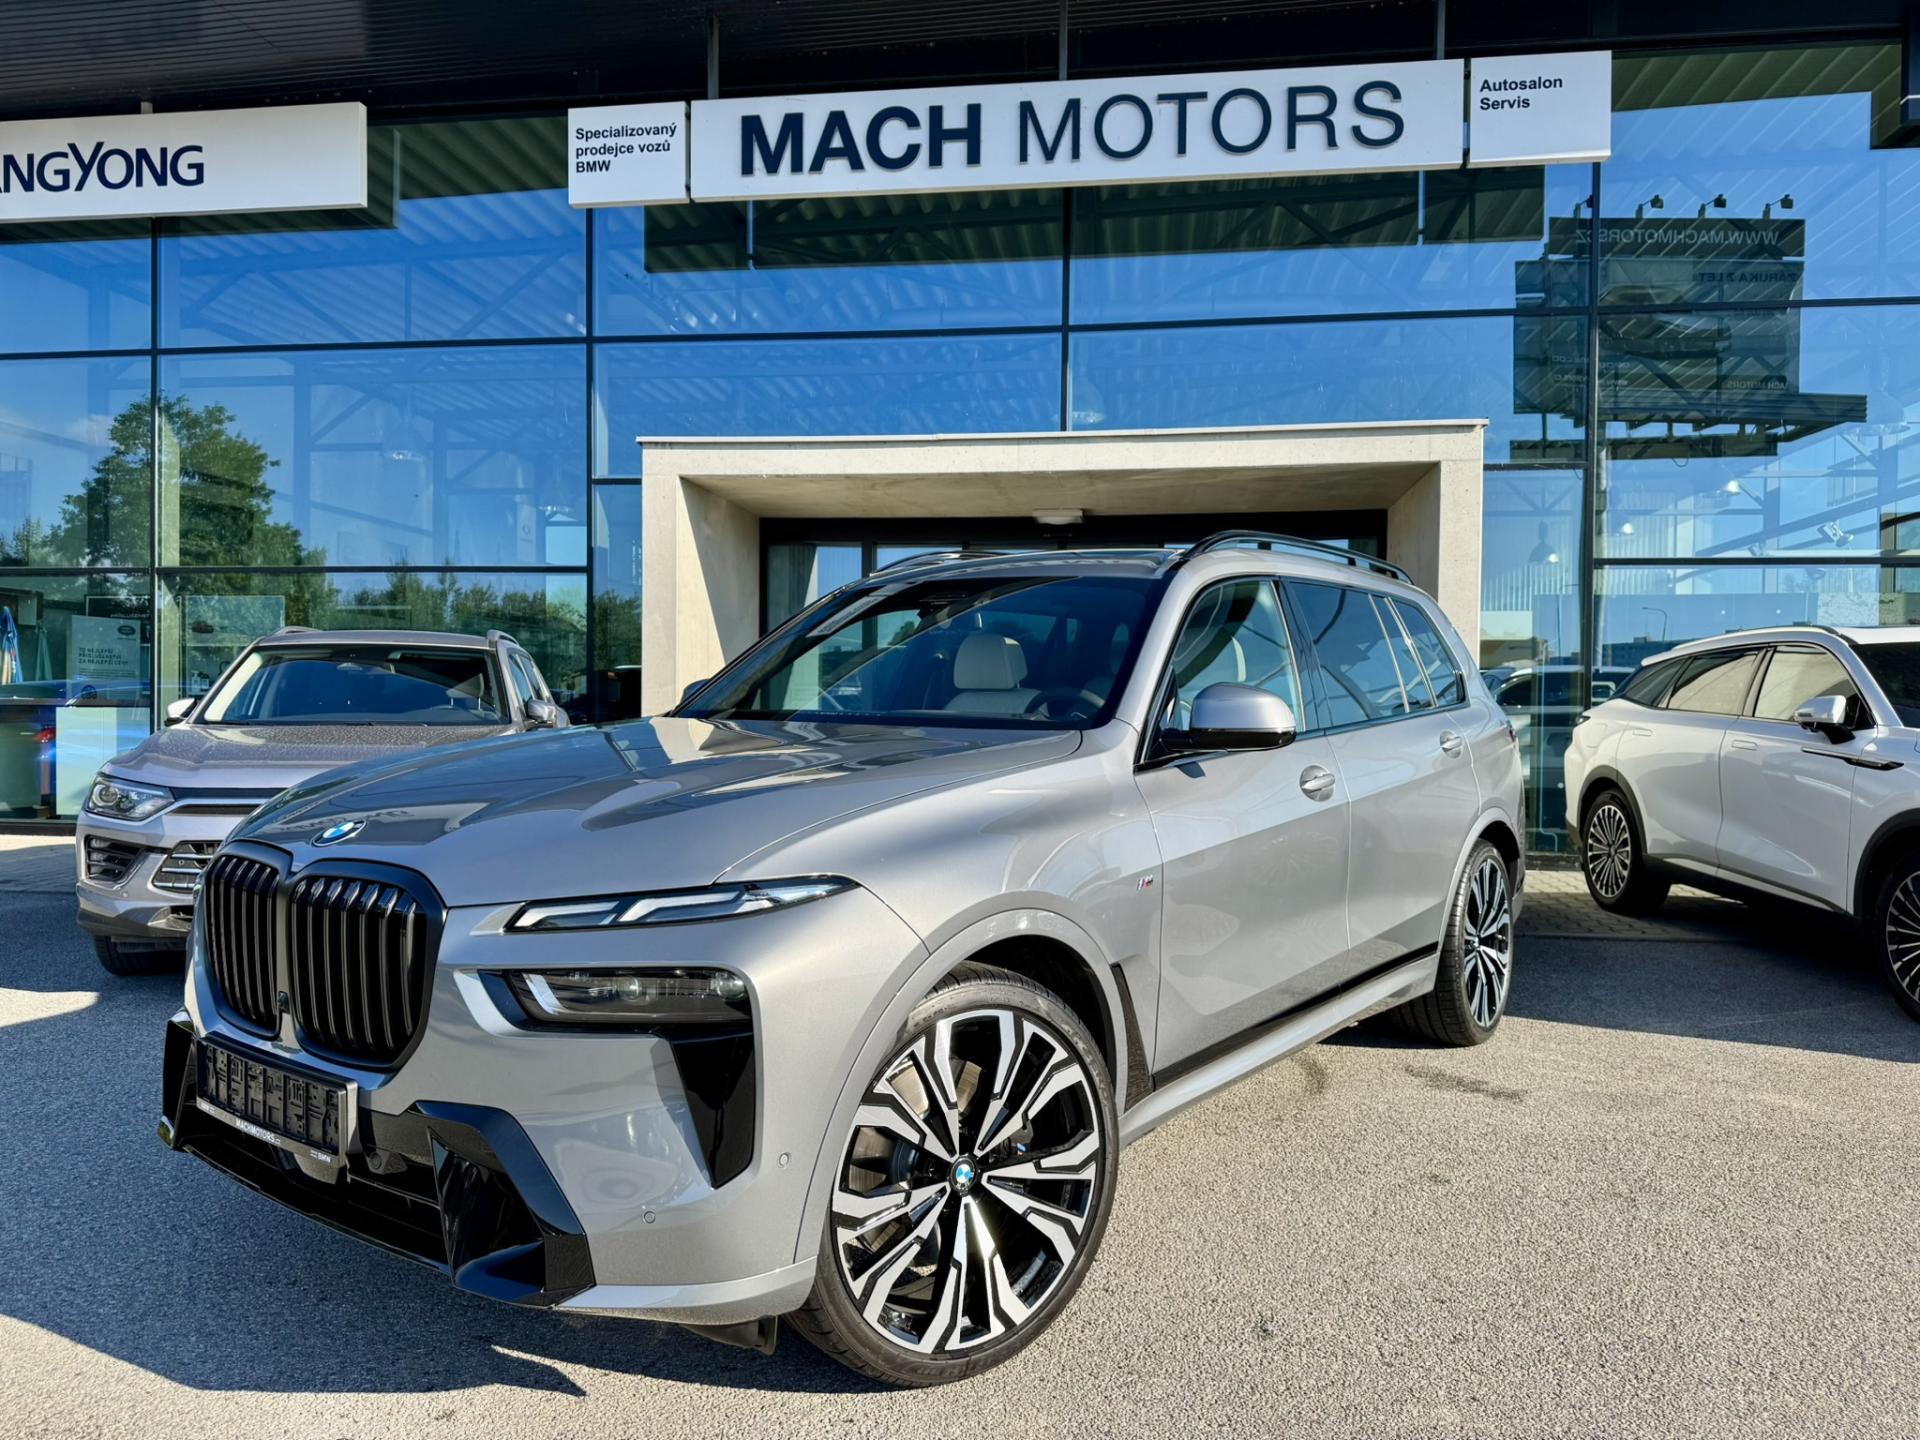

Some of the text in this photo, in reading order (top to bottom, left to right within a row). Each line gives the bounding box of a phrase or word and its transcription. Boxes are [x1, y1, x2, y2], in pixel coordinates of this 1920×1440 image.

[1480, 76, 1563, 93] Autosalon
[1480, 96, 1530, 111] Servis
[575, 122, 677, 142] Specializovaný
[740, 79, 1406, 177] MACH MOTORS
[576, 140, 671, 159] prodejce vozů
[0, 141, 205, 193] NGYONG
[576, 160, 611, 173] BMW
